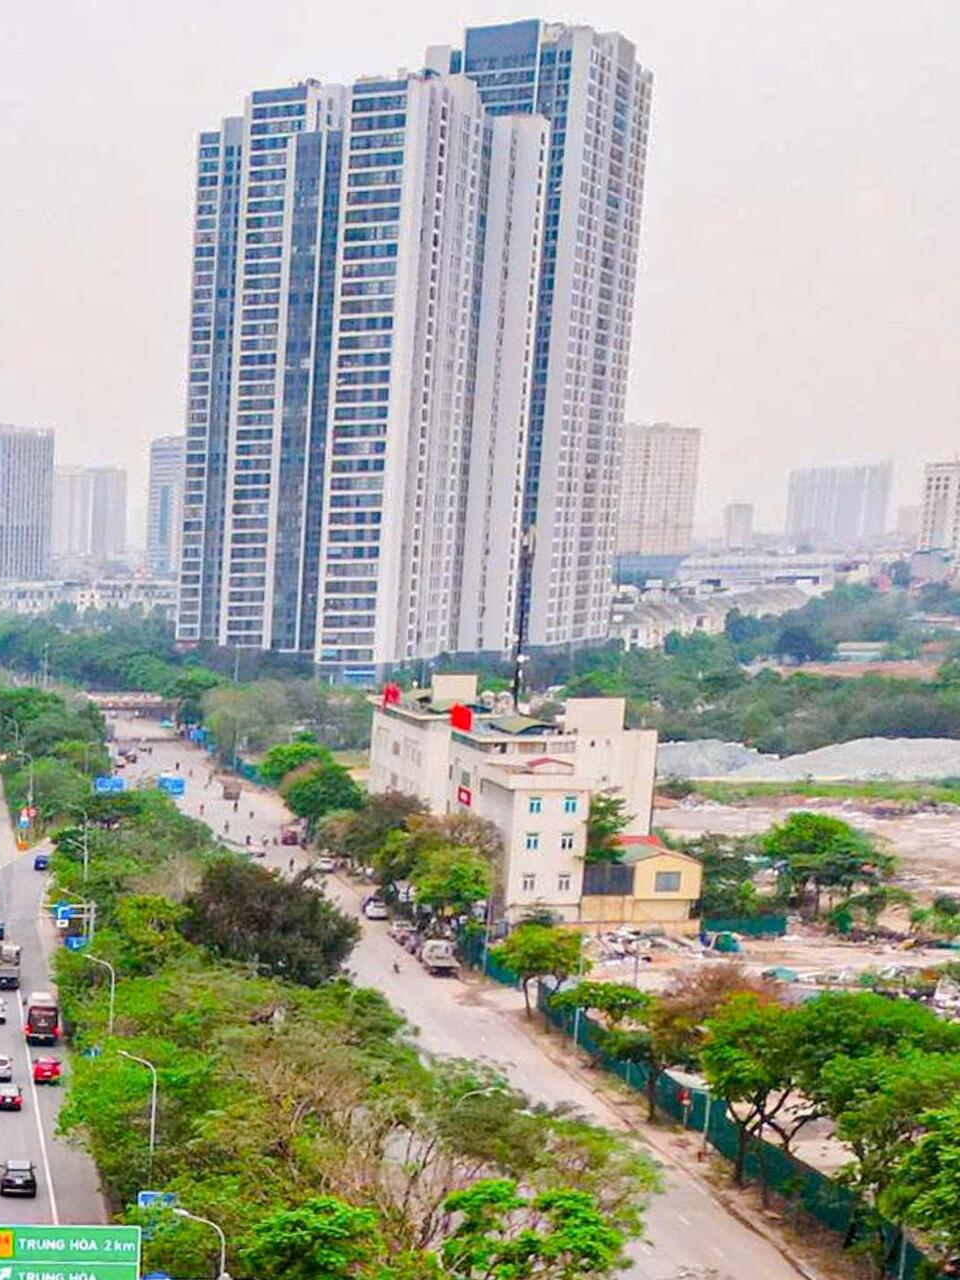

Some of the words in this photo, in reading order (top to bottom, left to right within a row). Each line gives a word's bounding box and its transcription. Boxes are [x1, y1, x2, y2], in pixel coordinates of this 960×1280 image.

[18, 1237, 65, 1251] TRUNG
[103, 1239, 113, 1252] 2
[113, 1239, 136, 1252] km
